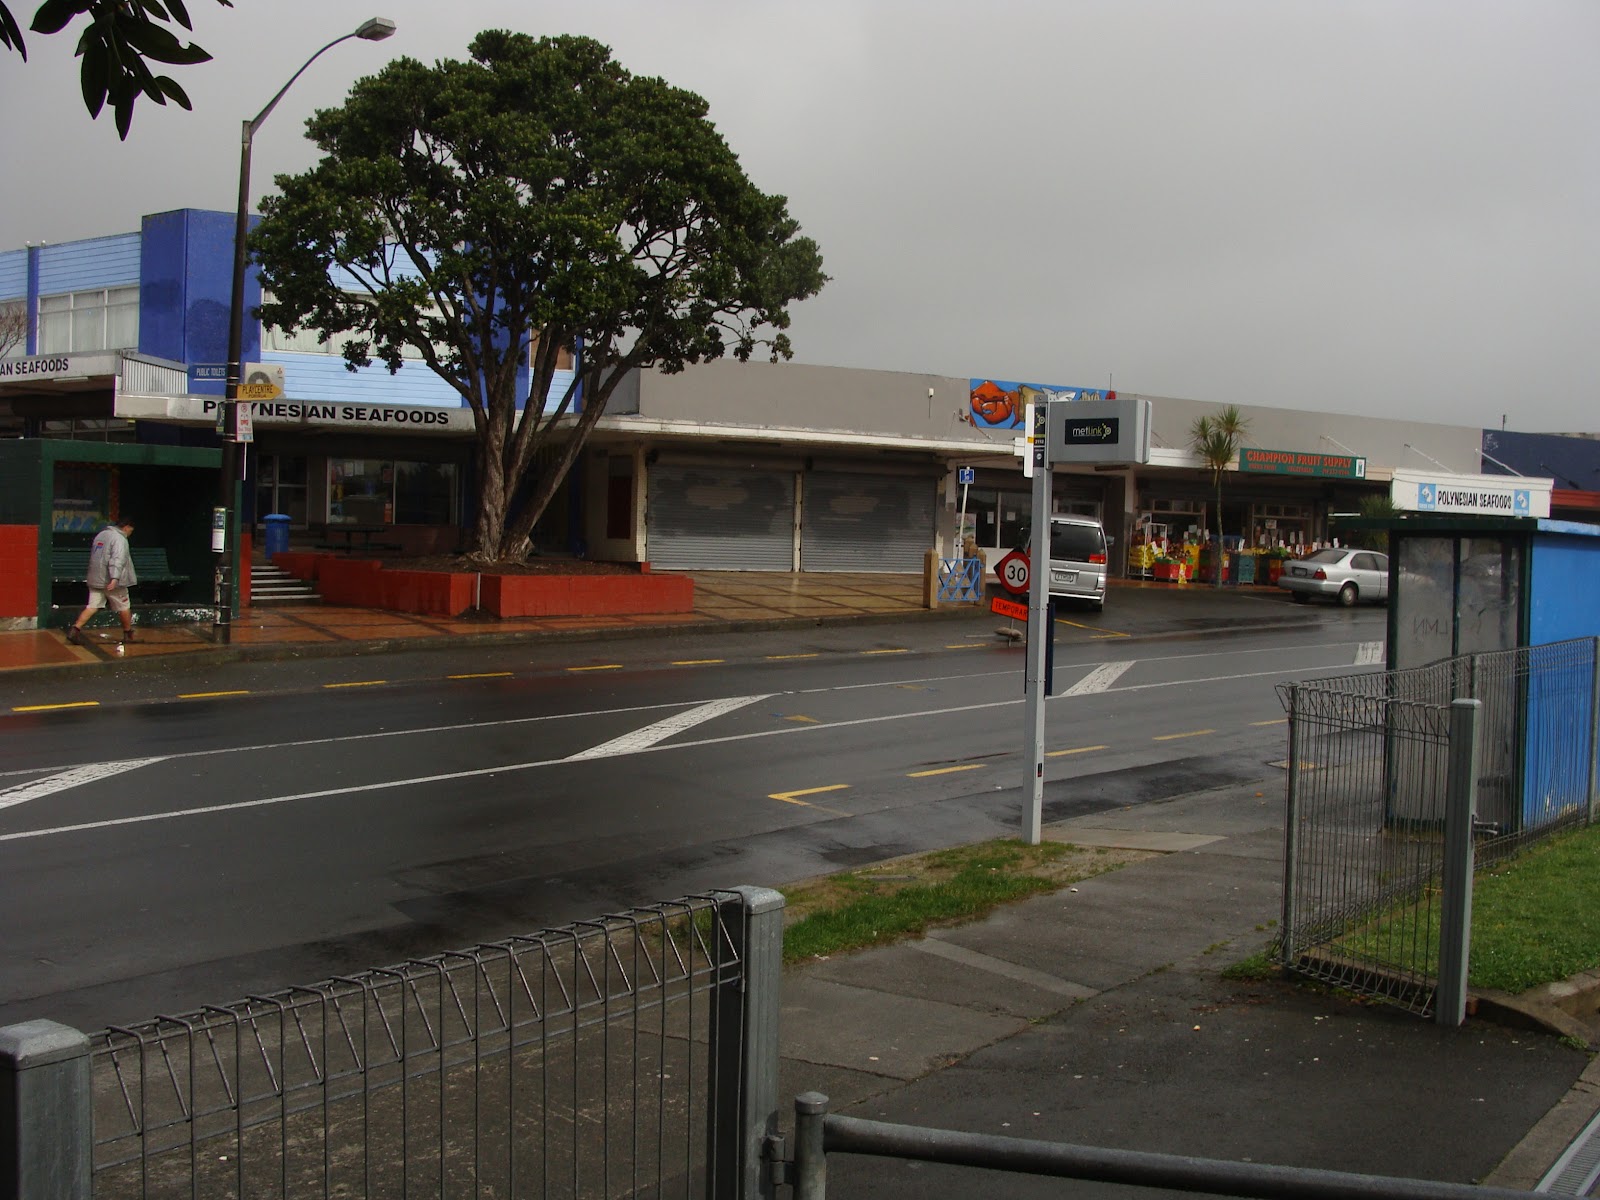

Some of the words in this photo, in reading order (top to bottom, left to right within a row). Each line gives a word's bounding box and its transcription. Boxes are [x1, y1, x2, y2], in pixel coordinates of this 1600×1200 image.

[15, 358, 69, 374] SEAFOODS
[196, 367, 210, 376] PUBLIC
[242, 385, 274, 394] PLAYCENTRE
[203, 400, 336, 419] PYNESIAN
[342, 407, 449, 424] SEAFOODS
[1073, 427, 1103, 437] metlink
[1246, 450, 1295, 464] CHAMPION
[1297, 455, 1320, 466] FRUIT
[1323, 457, 1352, 468] SUPPLY
[1437, 490, 1478, 507] POLYNESIAN
[1479, 493, 1512, 510] SEAFOODS
[1007, 565, 1026, 582] 30
[995, 601, 1027, 617] TEMPORAR
